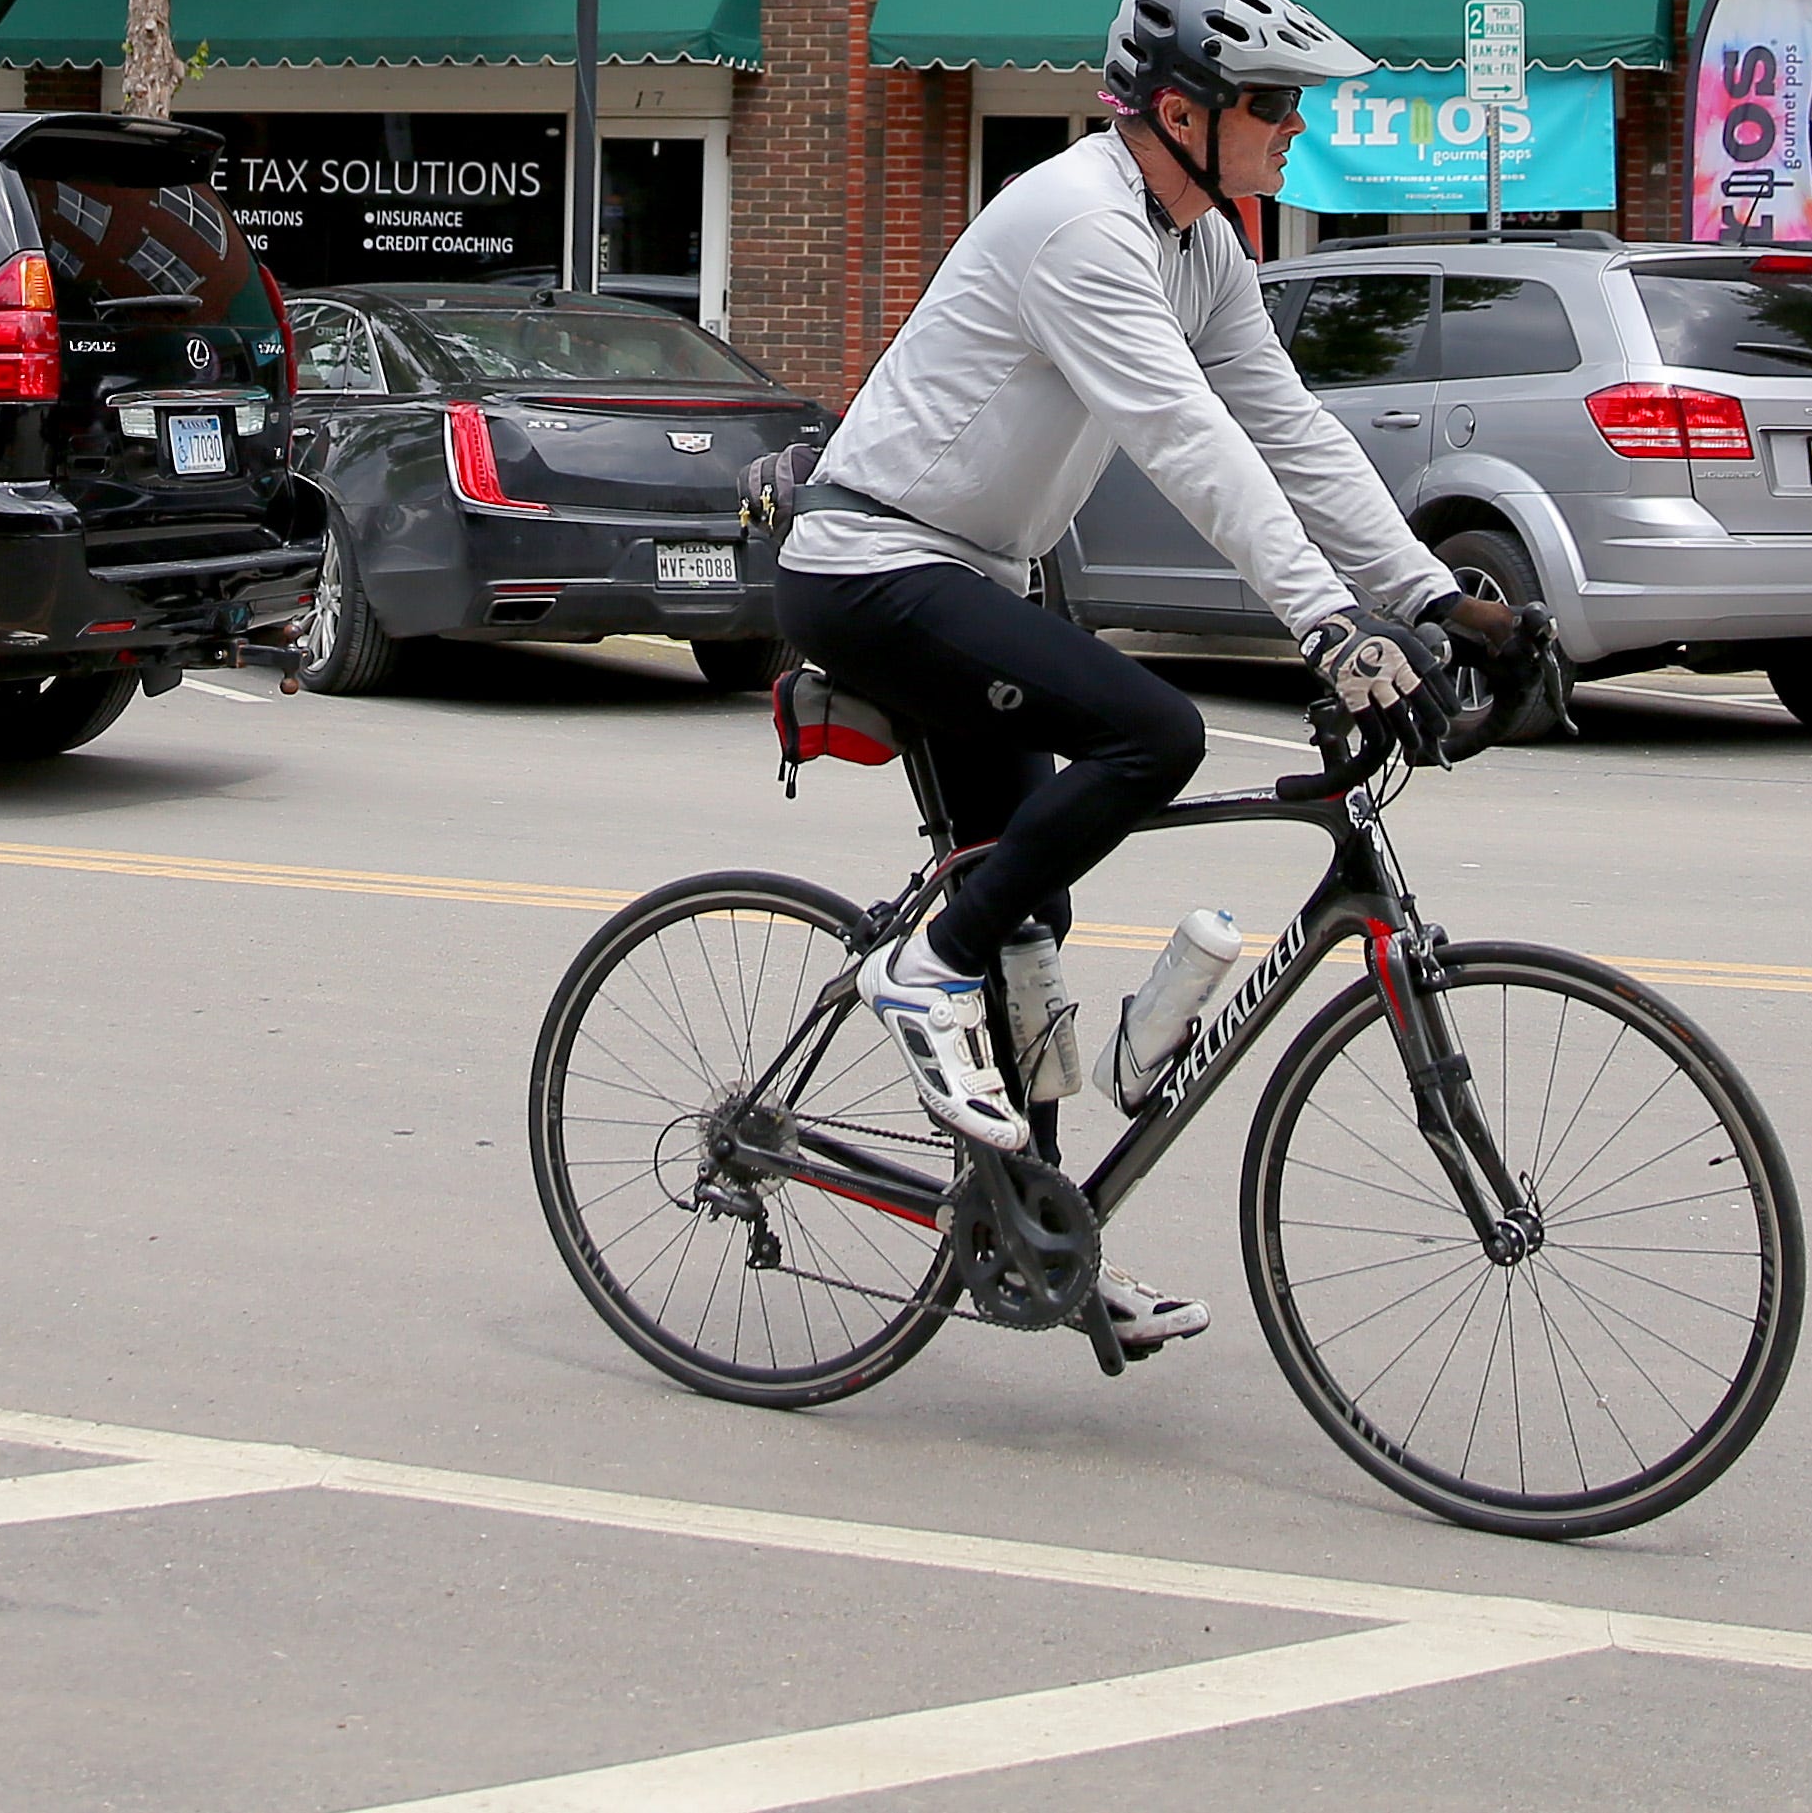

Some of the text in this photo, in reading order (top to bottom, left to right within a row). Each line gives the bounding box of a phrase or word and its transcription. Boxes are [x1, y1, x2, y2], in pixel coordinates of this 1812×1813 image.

[1470, 7, 1511, 34] 2 HR
[1486, 22, 1519, 35] PARKING
[1782, 44, 1804, 170] gourmet pops
[1432, 148, 1532, 167] gourme pops
[240, 158, 309, 193] TAX
[319, 159, 541, 197] SOLUTIONS
[376, 210, 464, 228] INSURANCE
[375, 235, 514, 254] CREDIT COACHING
[69, 339, 117, 353] LEXUS
[526, 420, 569, 431] XTS
[188, 434, 222, 462] 17030
[678, 544, 711, 556] TEXAS
[1161, 914, 1306, 1118] SPECIALIZED
